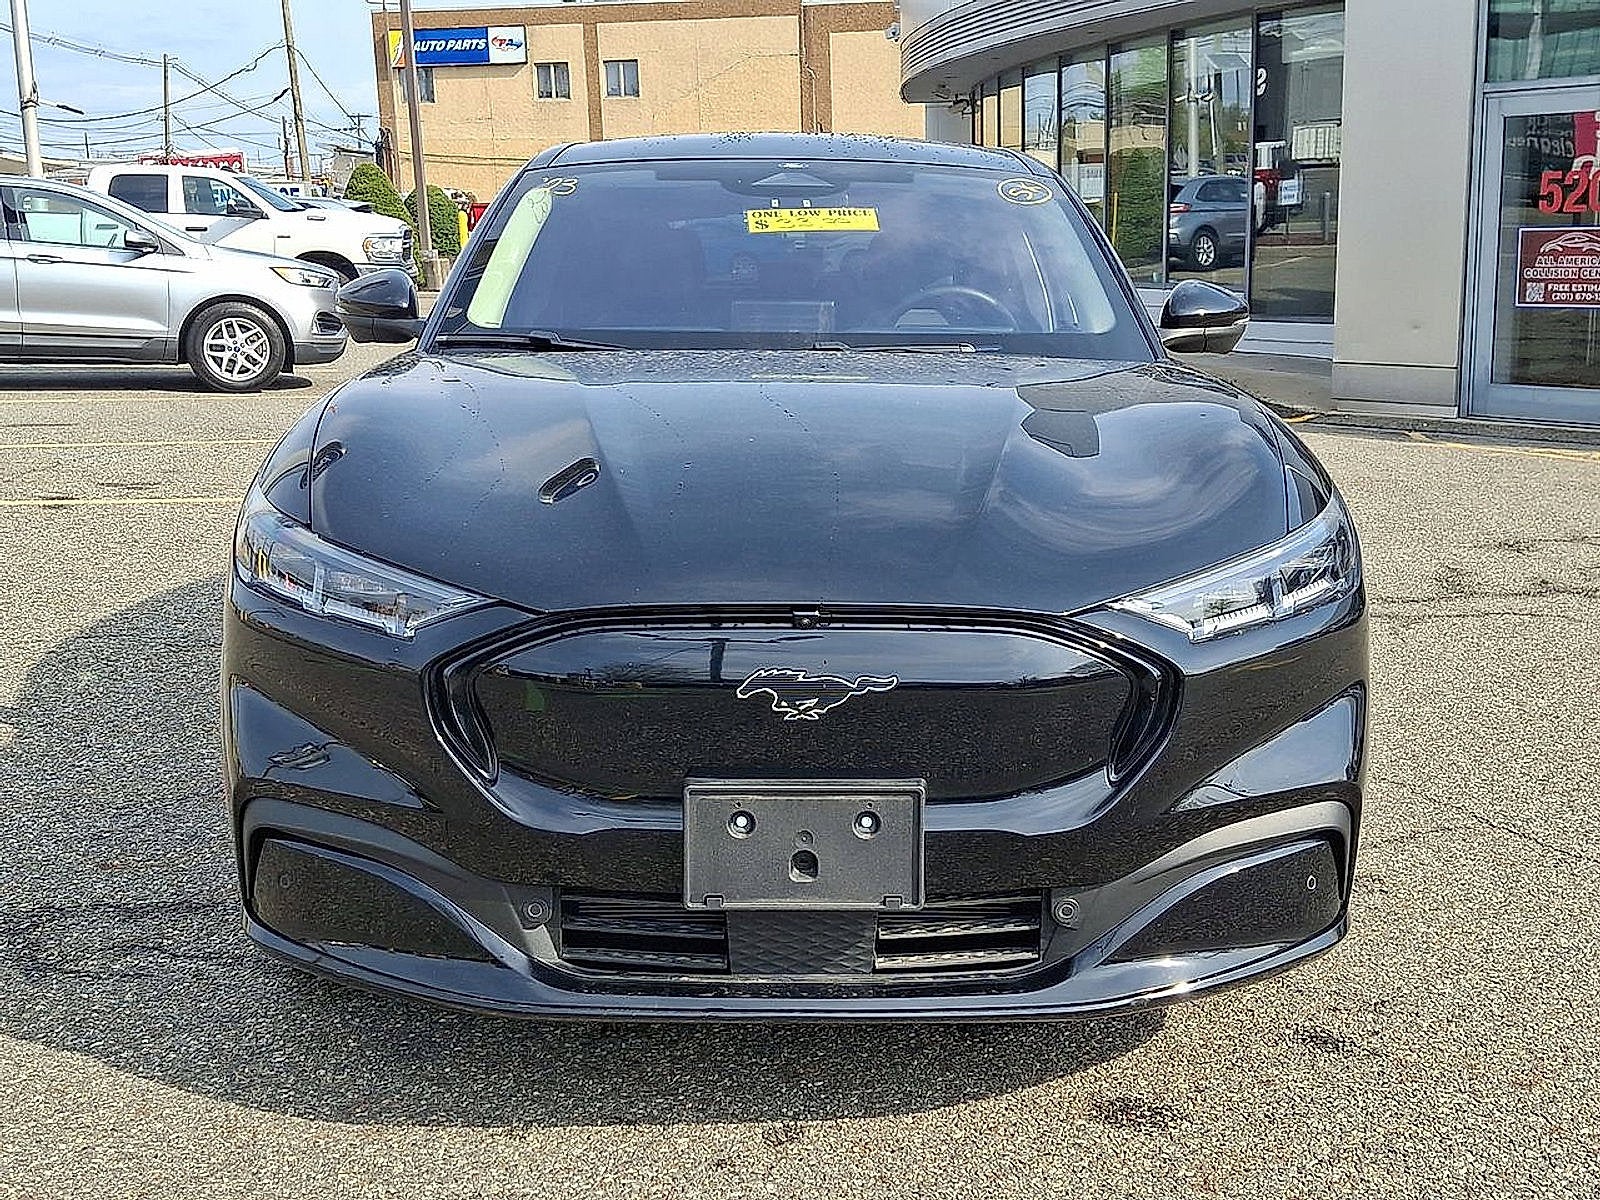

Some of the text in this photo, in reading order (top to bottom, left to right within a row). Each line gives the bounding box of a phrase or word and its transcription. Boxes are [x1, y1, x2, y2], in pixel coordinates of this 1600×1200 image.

[414, 39, 487, 52] AUTO PARTS
[828, 209, 871, 217] PRICE
[1535, 255, 1556, 267] ALL
[1524, 268, 1578, 279] COLLISION
[1548, 284, 1570, 292] FREE
